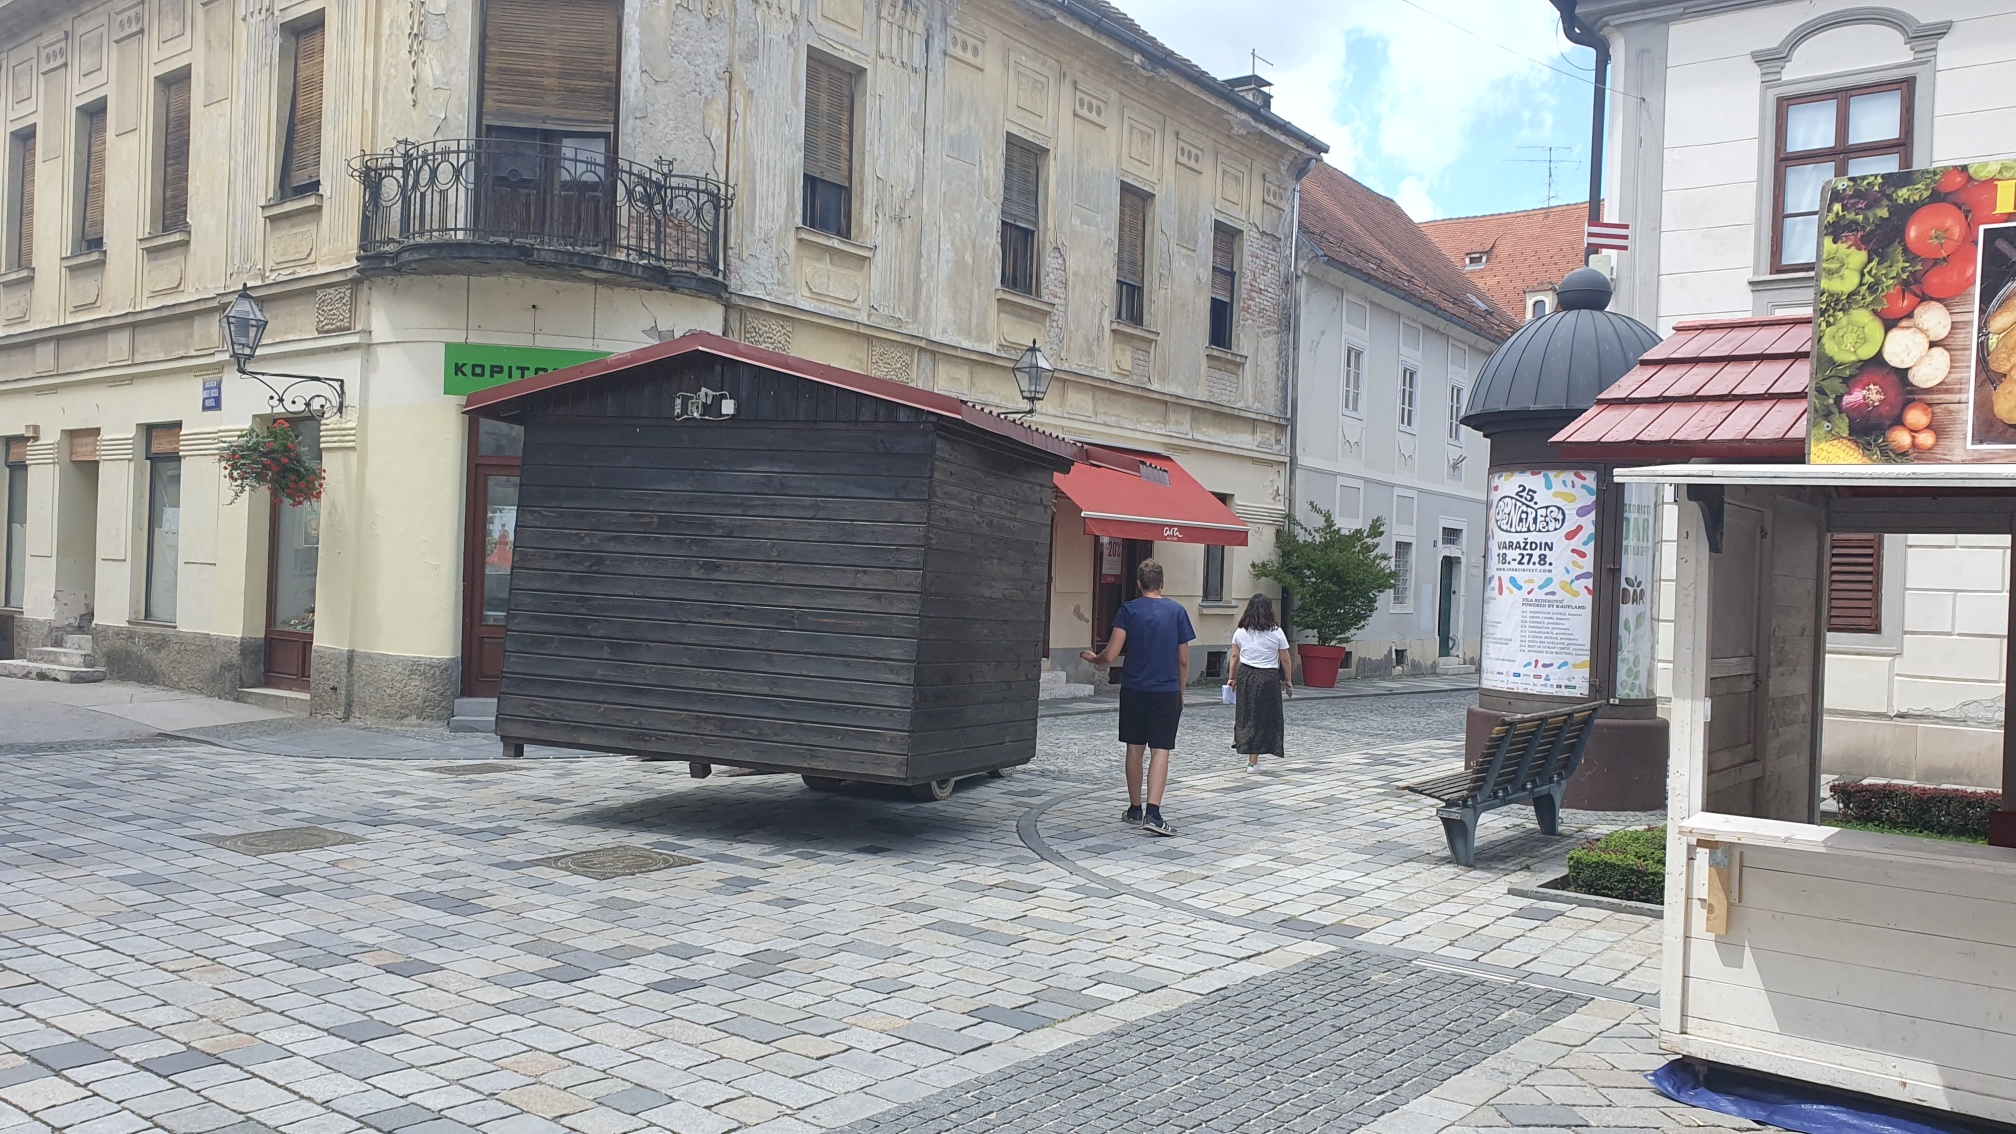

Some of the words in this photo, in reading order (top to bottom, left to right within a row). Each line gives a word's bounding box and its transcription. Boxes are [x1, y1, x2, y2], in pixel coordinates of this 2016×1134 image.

[454, 362, 562, 380] KOPIT
[1514, 484, 1538, 506] 25.
[1163, 526, 1184, 538] ara
[1497, 537, 1554, 552] VARAŽDIN
[1496, 552, 1553, 567] 18.-27.8.
[1621, 587, 1646, 606] DAR
